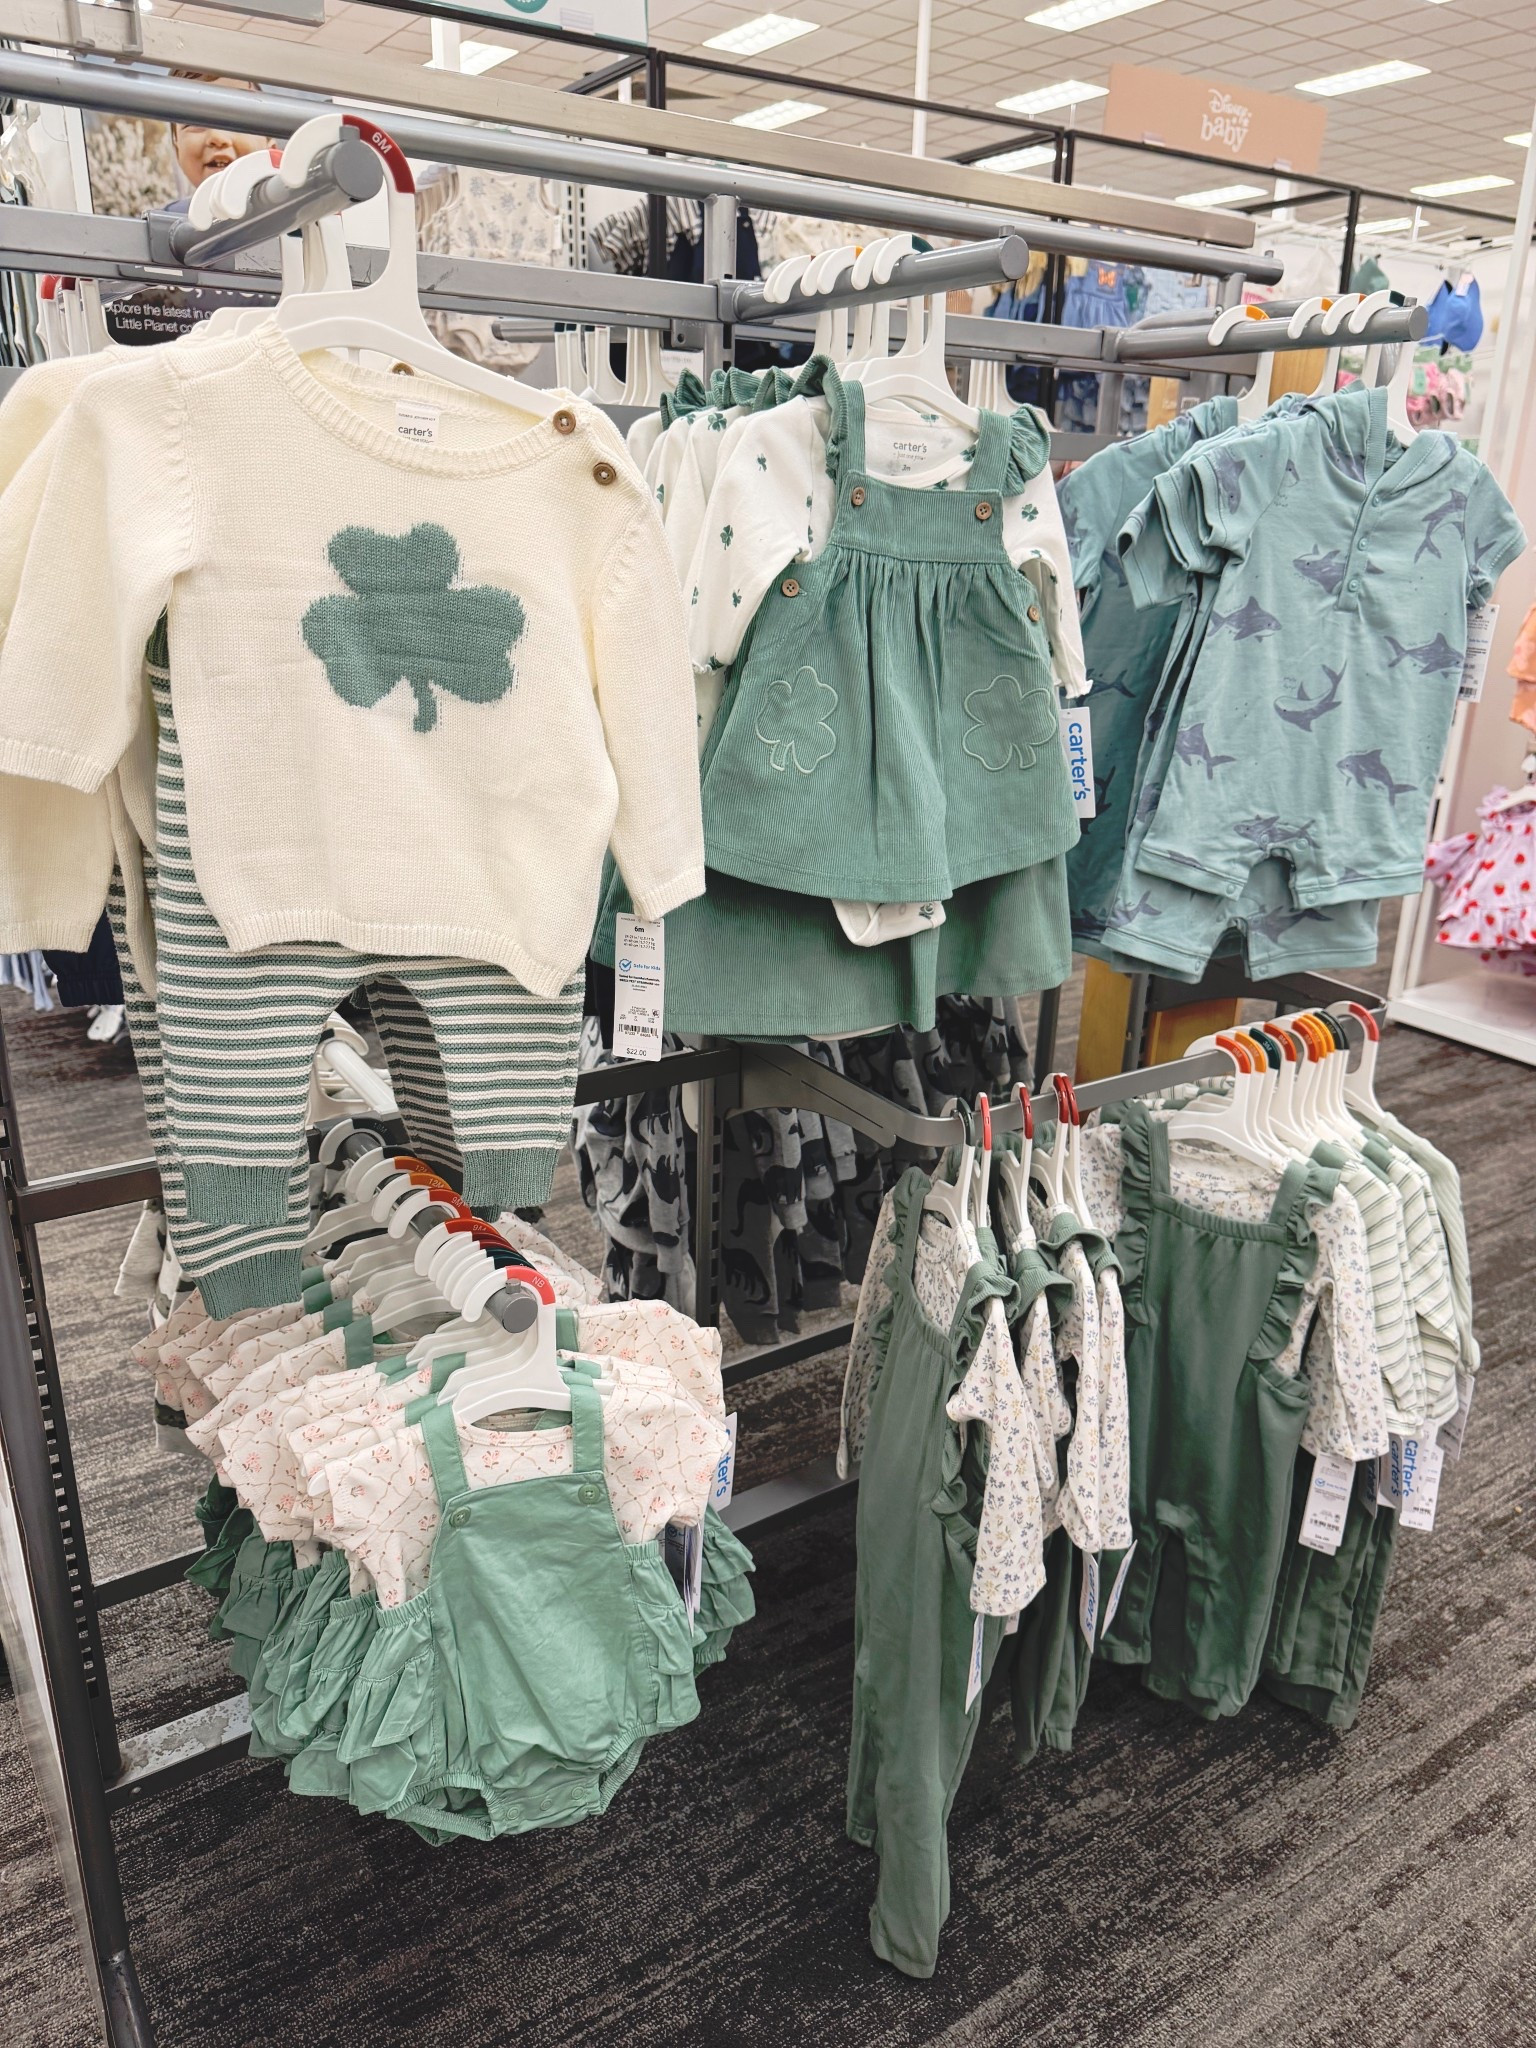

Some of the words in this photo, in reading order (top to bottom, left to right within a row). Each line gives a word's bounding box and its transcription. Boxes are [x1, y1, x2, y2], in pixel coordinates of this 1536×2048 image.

[1200, 113, 1249, 153] baby
[372, 131, 392, 154] 6M
[143, 304, 160, 317] the
[162, 307, 193, 319] latest
[193, 309, 203, 321] in
[115, 316, 142, 331] Little
[143, 318, 178, 333] Planet
[398, 426, 433, 437] carter's
[893, 442, 928, 453] carter's
[1068, 722, 1091, 801] carter's
[634, 925, 645, 933] 6m
[626, 1047, 647, 1057] $22.00
[531, 1276, 545, 1288] NB
[716, 1429, 732, 1498] ter's
[1392, 1440, 1402, 1497] carter's
